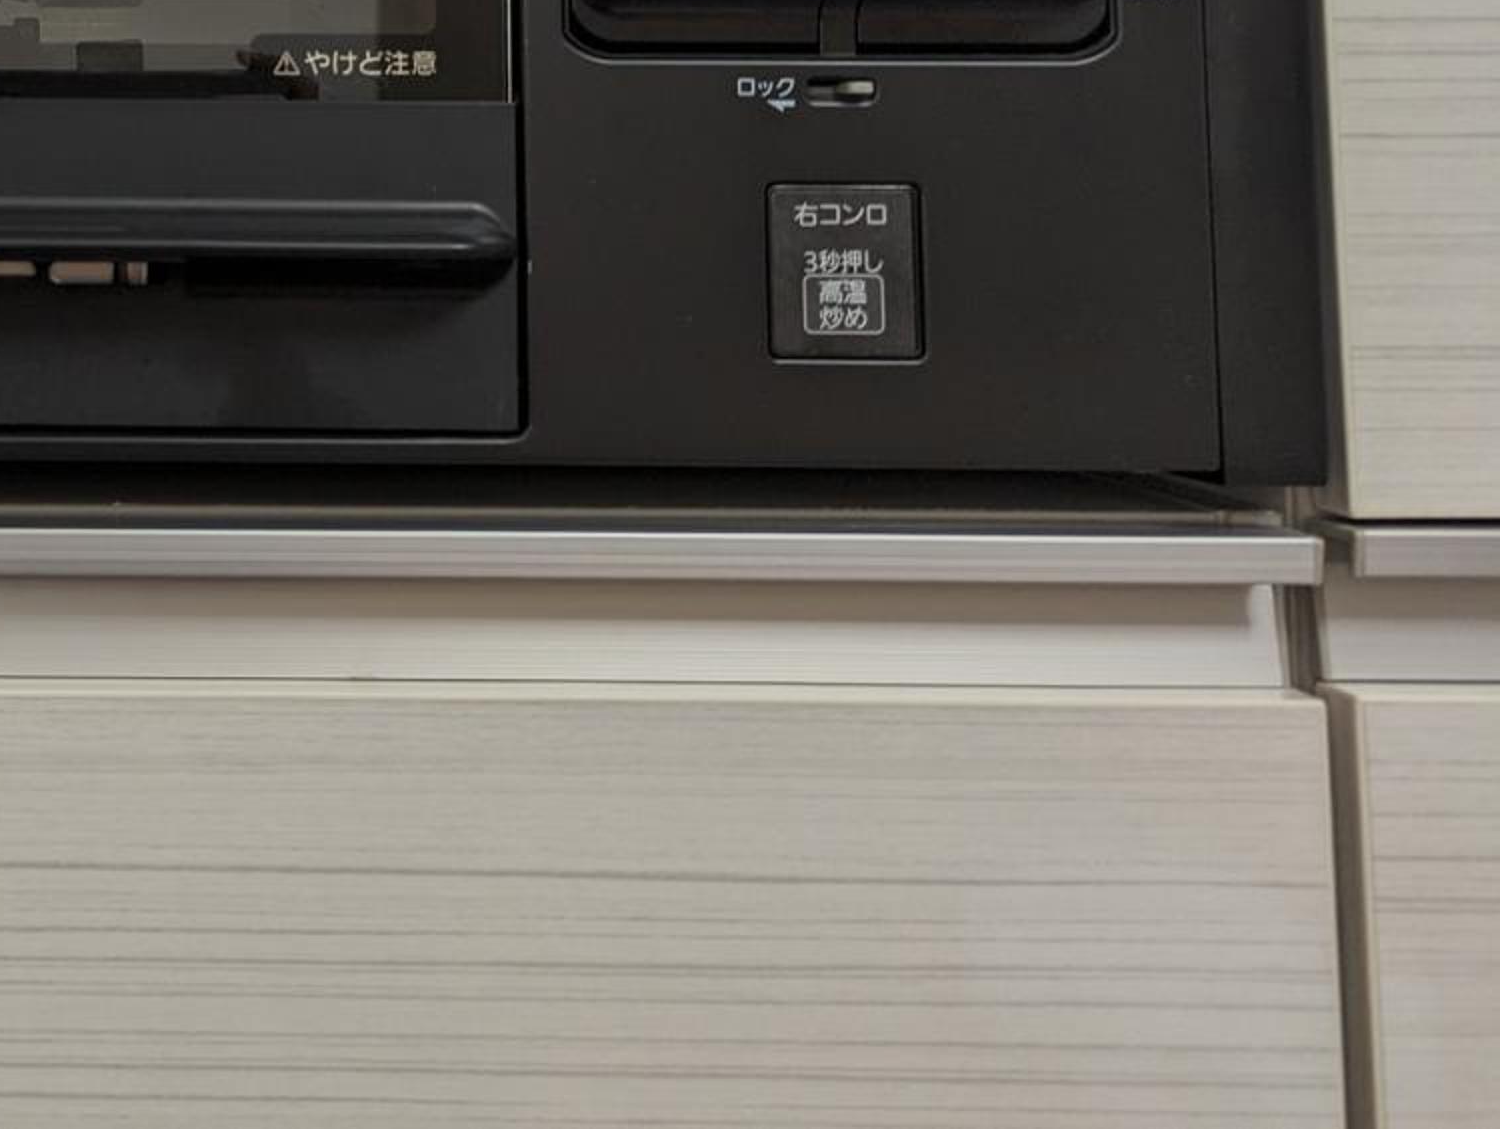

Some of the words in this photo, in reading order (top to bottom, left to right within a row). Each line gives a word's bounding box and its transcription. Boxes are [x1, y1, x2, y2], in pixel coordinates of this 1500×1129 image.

[303, 50, 437, 76] やけど注意
[737, 77, 796, 97] ロック
[793, 201, 887, 228] 右コンロ
[803, 248, 884, 274] 3秒押し
[819, 279, 867, 304] 高温
[819, 305, 868, 330] 炒め
